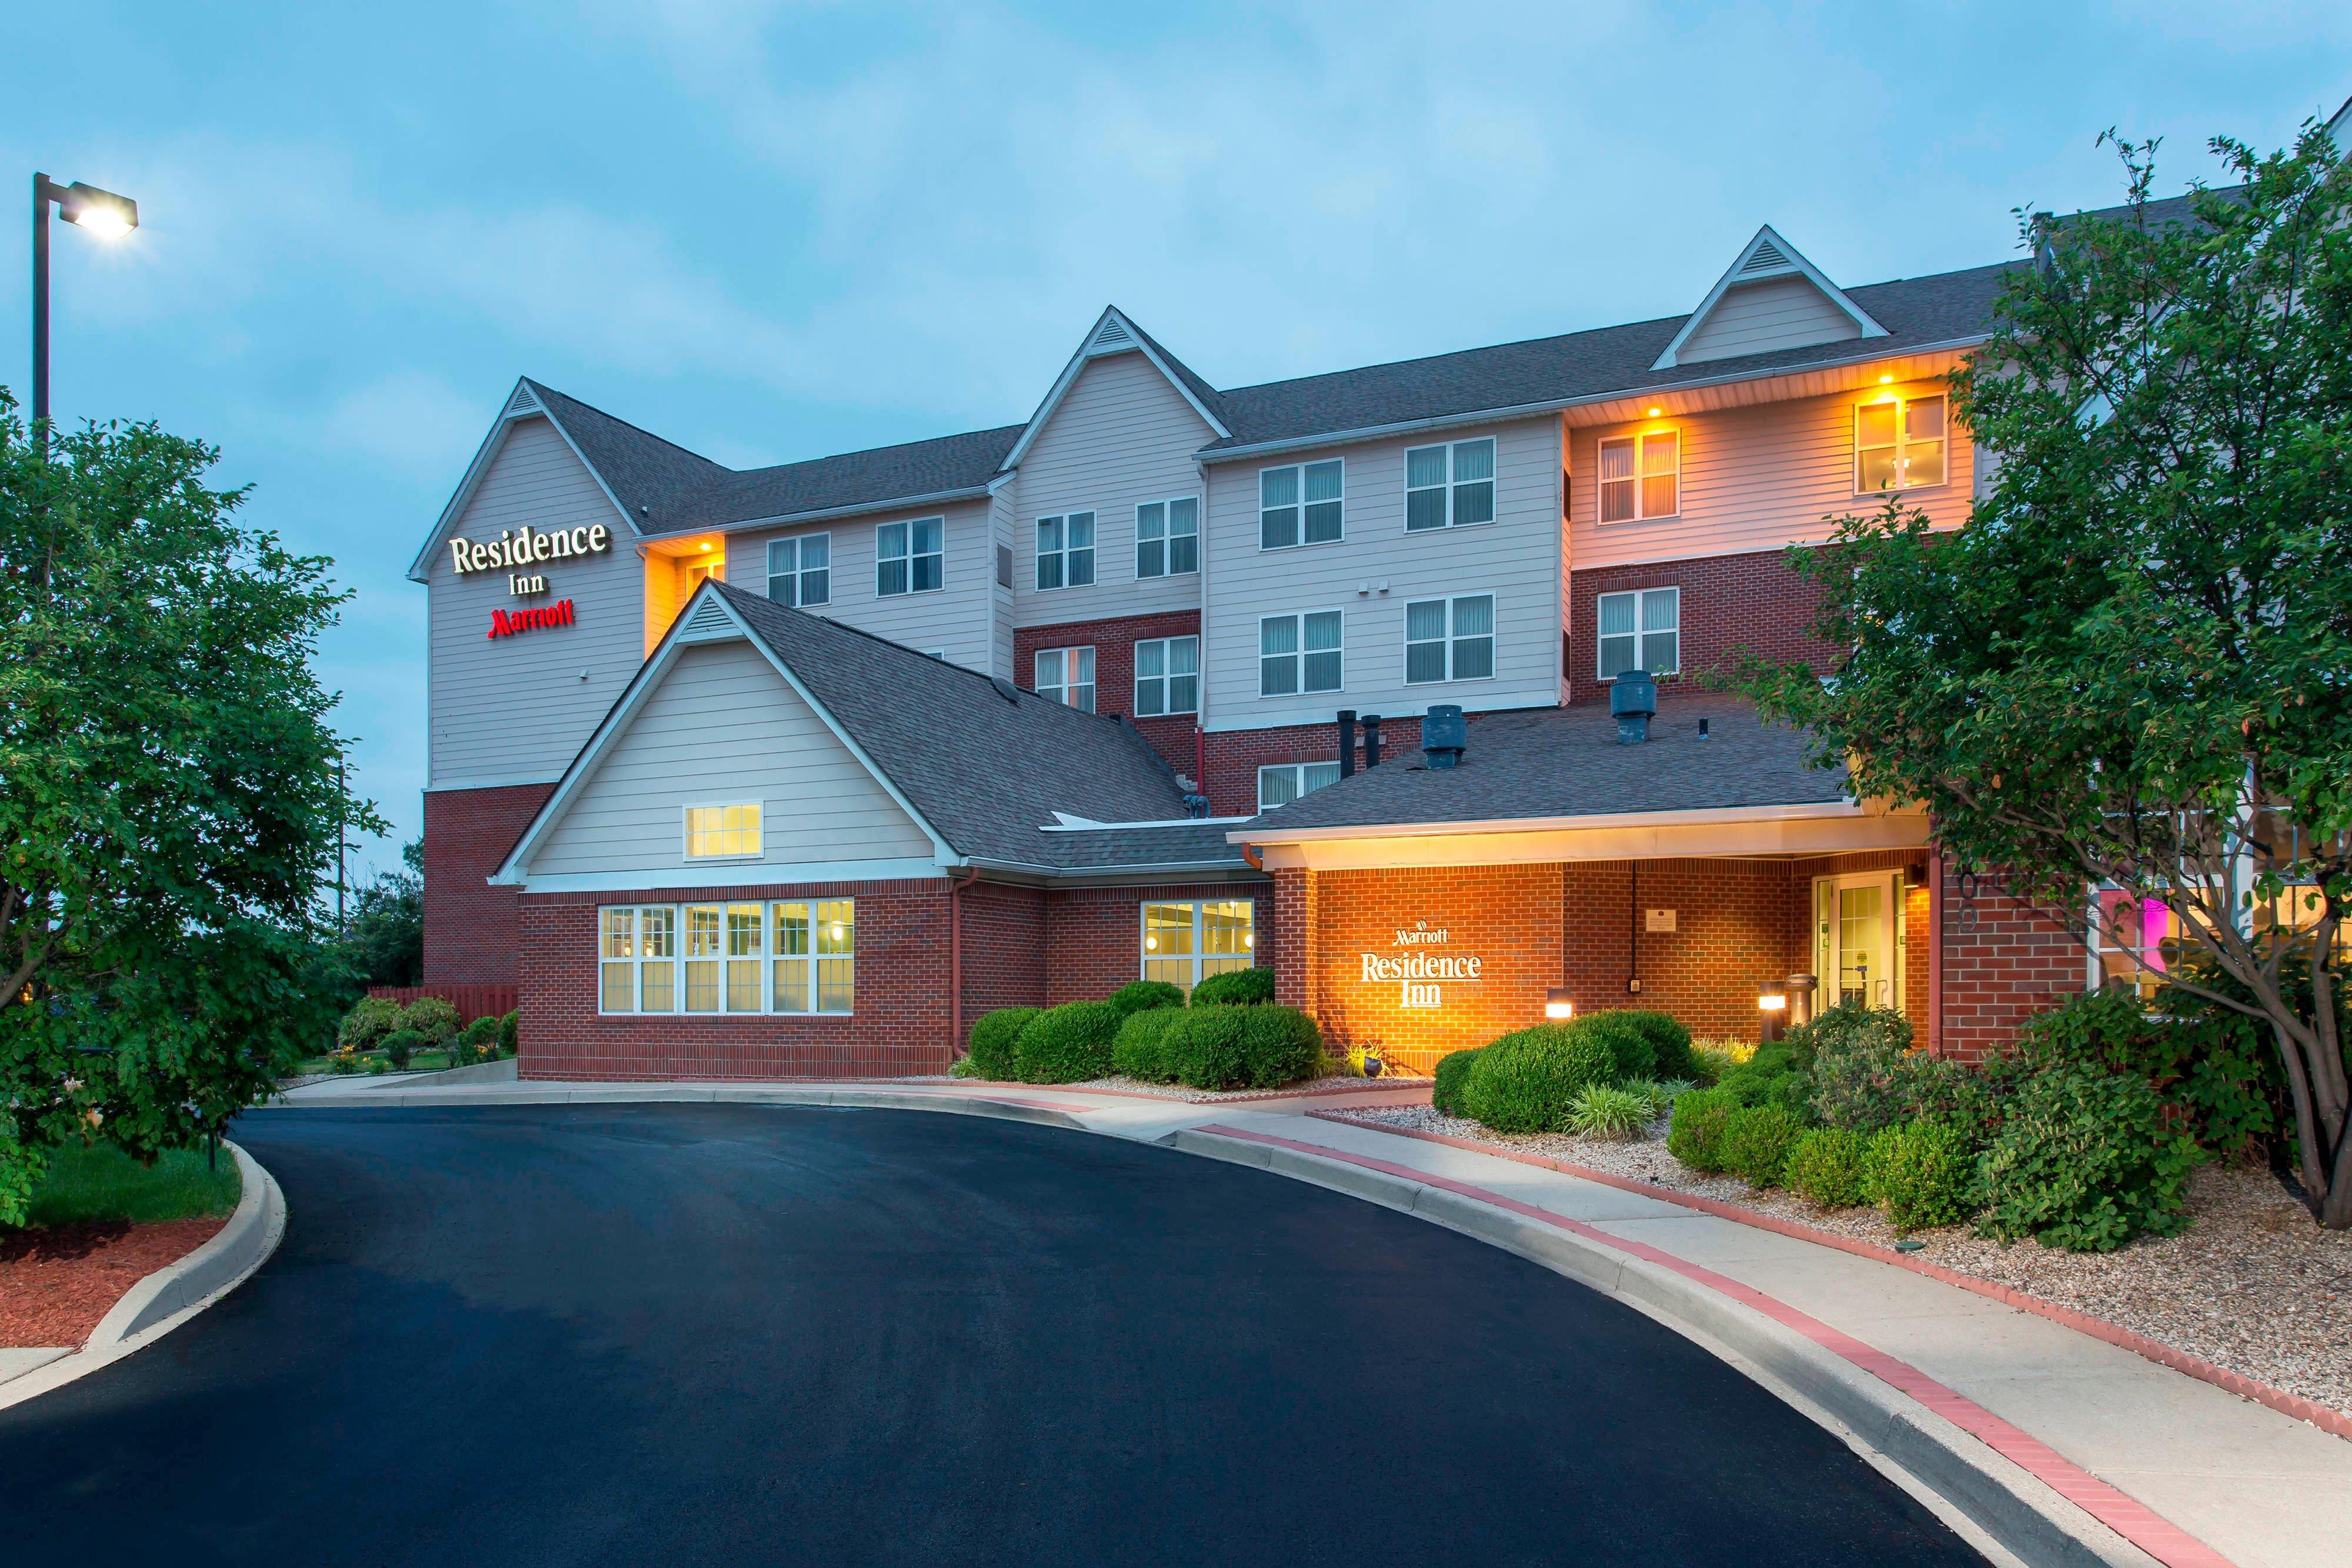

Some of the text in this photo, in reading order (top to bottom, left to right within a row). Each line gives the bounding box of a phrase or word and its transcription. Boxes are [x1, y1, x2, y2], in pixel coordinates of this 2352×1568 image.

[449, 524, 607, 574] Residence
[509, 573, 544, 596] Inn
[487, 599, 574, 639] Marriott
[1392, 928, 1448, 947] Marriott
[1361, 951, 1482, 982] Residence
[1400, 979, 1442, 1008] Inn
